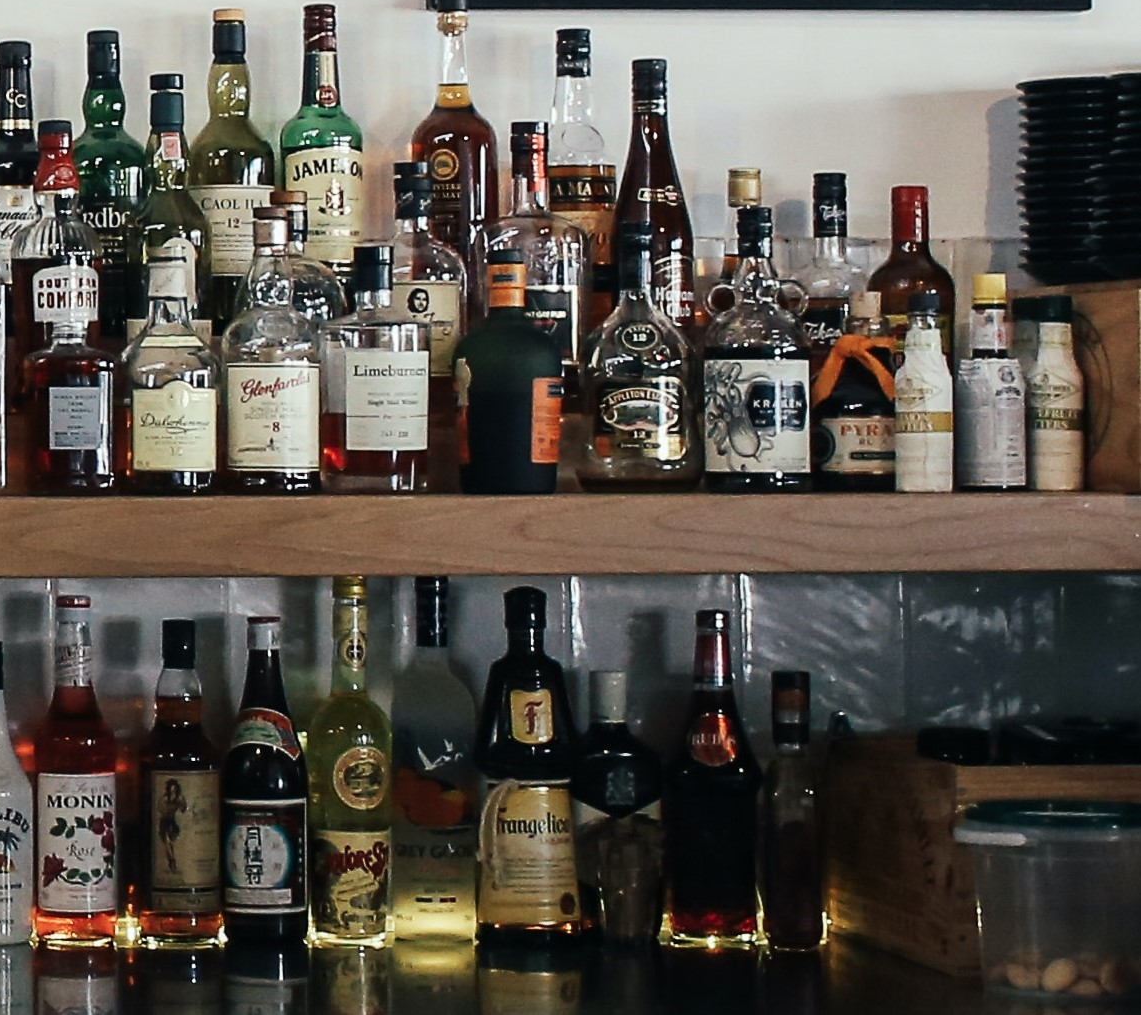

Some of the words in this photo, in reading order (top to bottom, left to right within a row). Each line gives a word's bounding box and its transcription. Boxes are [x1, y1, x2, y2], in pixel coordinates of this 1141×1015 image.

[201, 197, 240, 210] CAOL
[226, 218, 240, 229] 12
[272, 421, 281, 432] 8
[47, 794, 113, 809] MONIN
